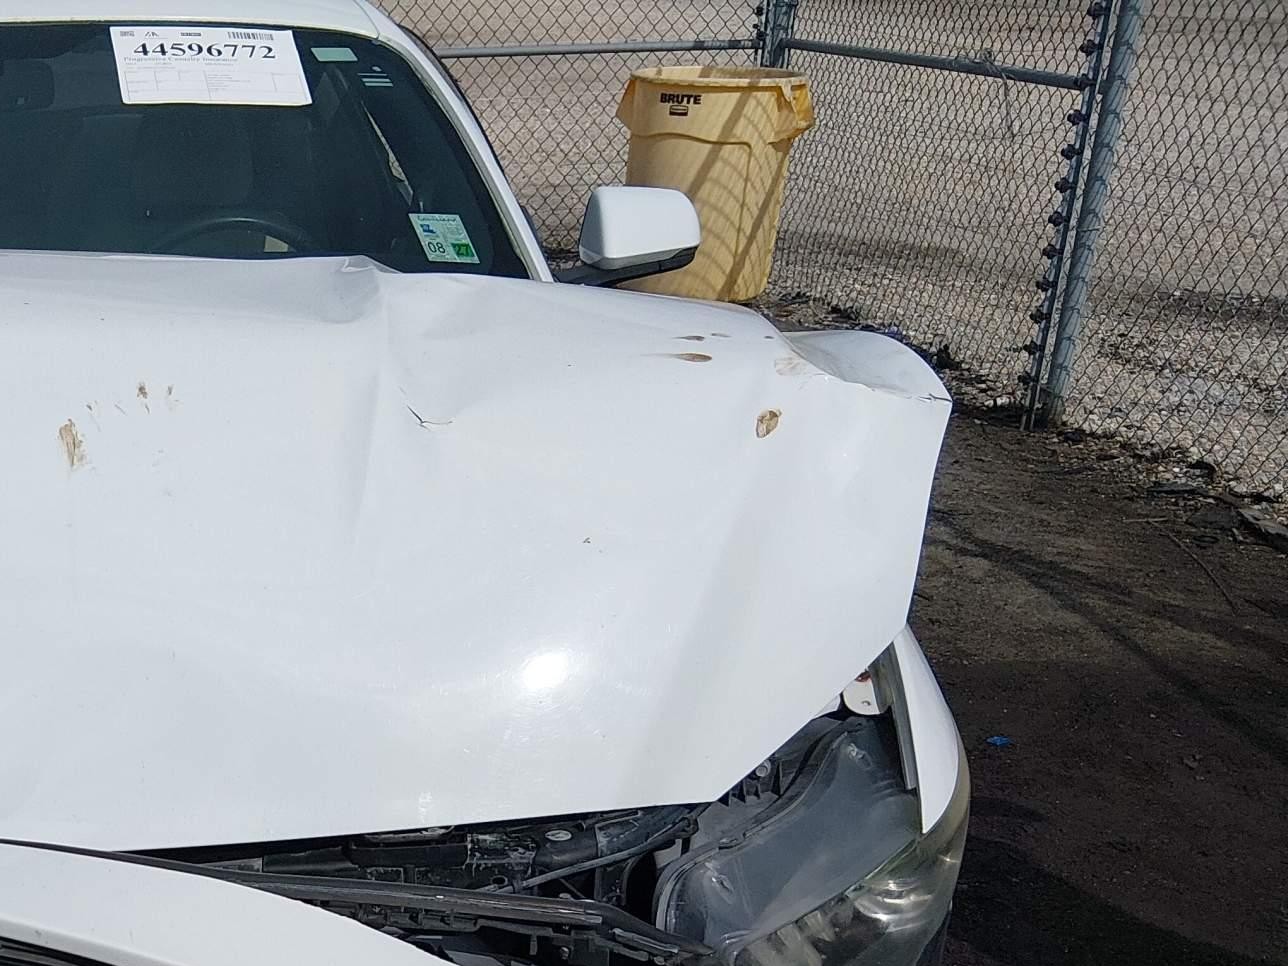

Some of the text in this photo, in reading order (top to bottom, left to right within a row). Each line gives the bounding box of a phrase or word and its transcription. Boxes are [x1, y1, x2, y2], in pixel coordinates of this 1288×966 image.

[133, 42, 276, 59] 44596772
[660, 93, 702, 105] BRUTE
[427, 241, 446, 254] 08
